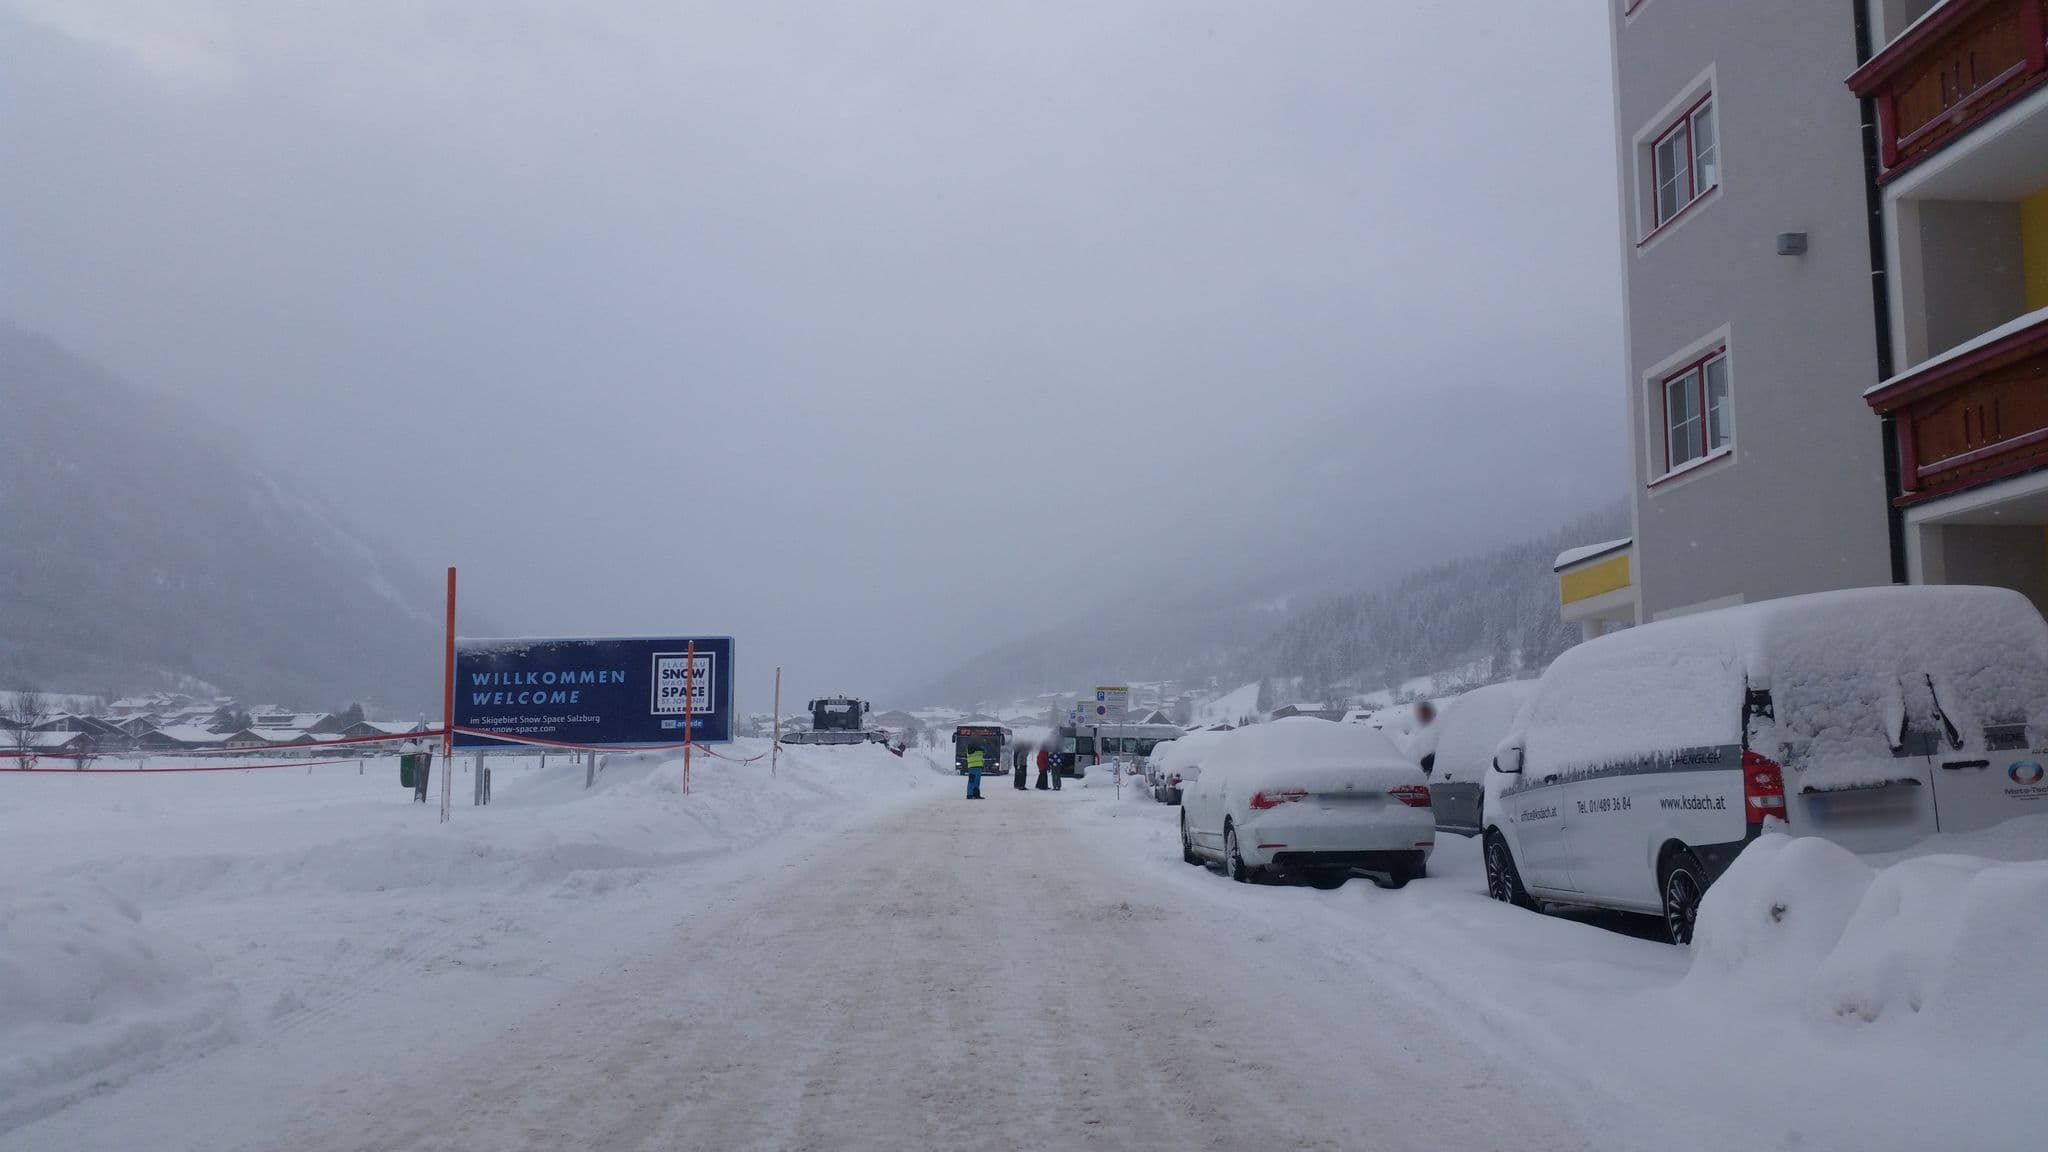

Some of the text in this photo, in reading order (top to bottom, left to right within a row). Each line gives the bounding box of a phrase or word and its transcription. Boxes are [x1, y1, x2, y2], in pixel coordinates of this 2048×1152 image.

[472, 670, 625, 686] WILLKOMMEN
[662, 668, 705, 679] SNOW
[473, 690, 580, 705] WELCOME
[662, 686, 705, 697] SPACE
[481, 716, 517, 726] Skigebiet
[519, 716, 541, 724] Snow
[543, 715, 565, 725] Space
[567, 714, 600, 724] Salzburg
[1589, 798, 1610, 812] 01/489
[1610, 797, 1621, 811] 36
[1622, 796, 1632, 810] 84
[1660, 794, 1726, 810] www.ksdach.at
